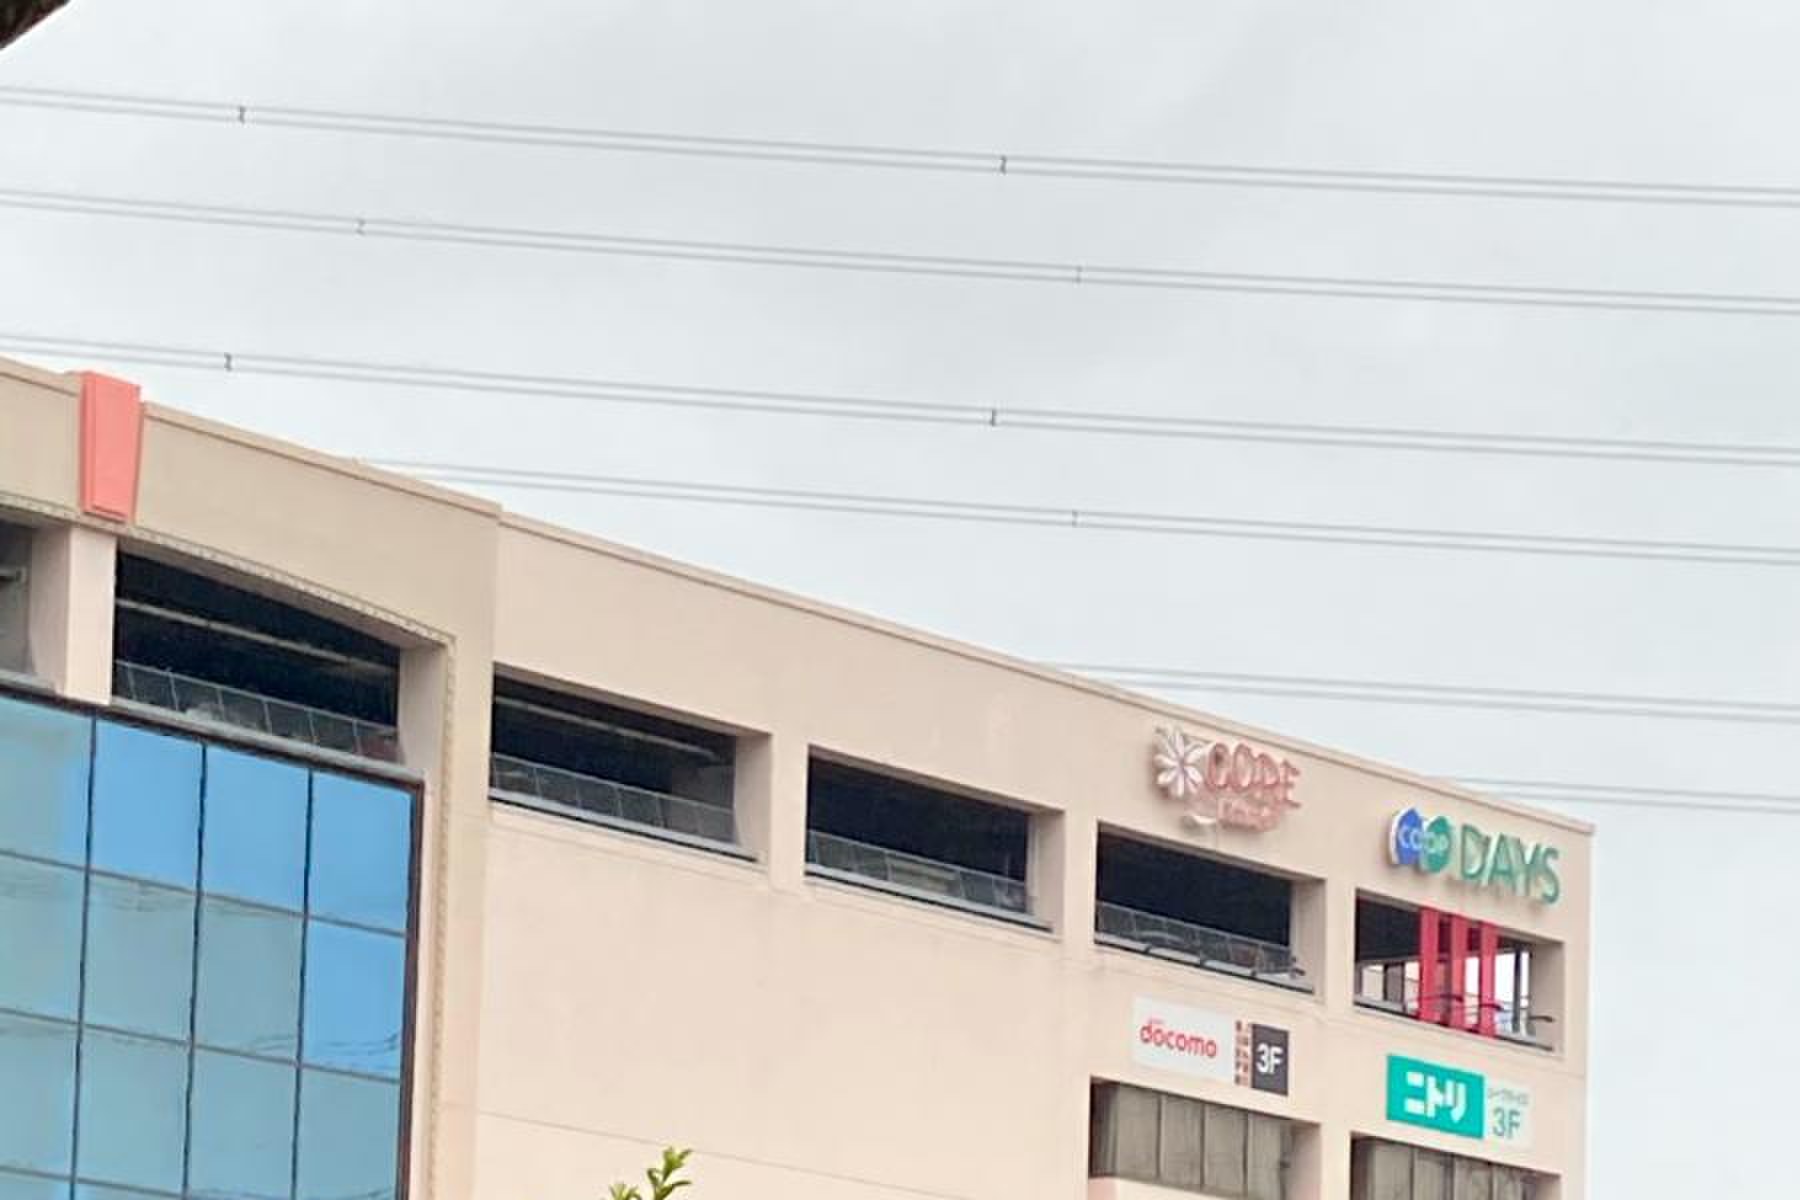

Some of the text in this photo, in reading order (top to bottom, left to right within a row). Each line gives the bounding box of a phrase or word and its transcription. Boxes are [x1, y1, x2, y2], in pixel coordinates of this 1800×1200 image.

[1461, 824, 1560, 904] DAYS
[1140, 1018, 1217, 1058] docomo
[1256, 1043, 1283, 1074] 3F
[1404, 1071, 1467, 1124] ニトリ
[1493, 1107, 1521, 1139] 3F
